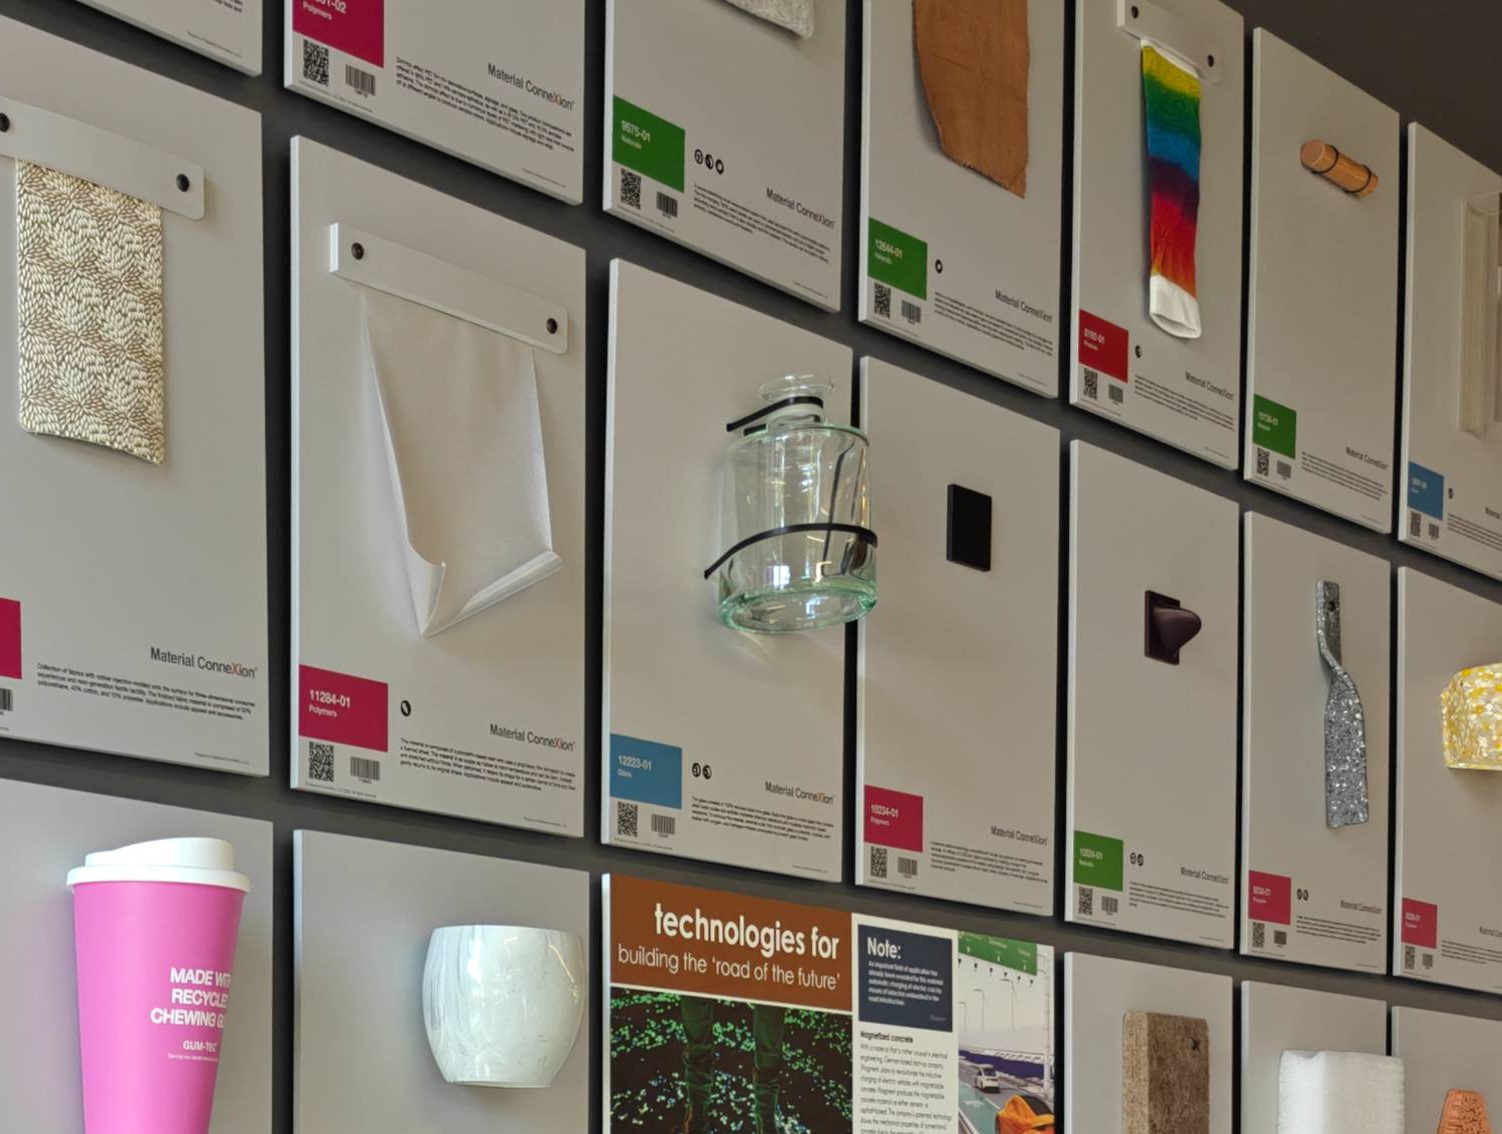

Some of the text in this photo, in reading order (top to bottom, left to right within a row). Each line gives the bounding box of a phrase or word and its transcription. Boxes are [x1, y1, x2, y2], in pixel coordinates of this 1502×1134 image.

[487, 62, 524, 89] Material
[150, 646, 194, 668] Material
[489, 722, 525, 742] Material
[764, 780, 794, 798] Material
[654, 902, 840, 960] technologies for
[867, 936, 901, 960] Note:
[617, 943, 679, 974] building
[683, 952, 707, 973] the
[753, 963, 770, 981] of
[771, 965, 795, 985] the
[170, 967, 214, 986] MADE
[171, 988, 228, 1009] RECYCLE
[150, 1007, 217, 1028] CHEWING
